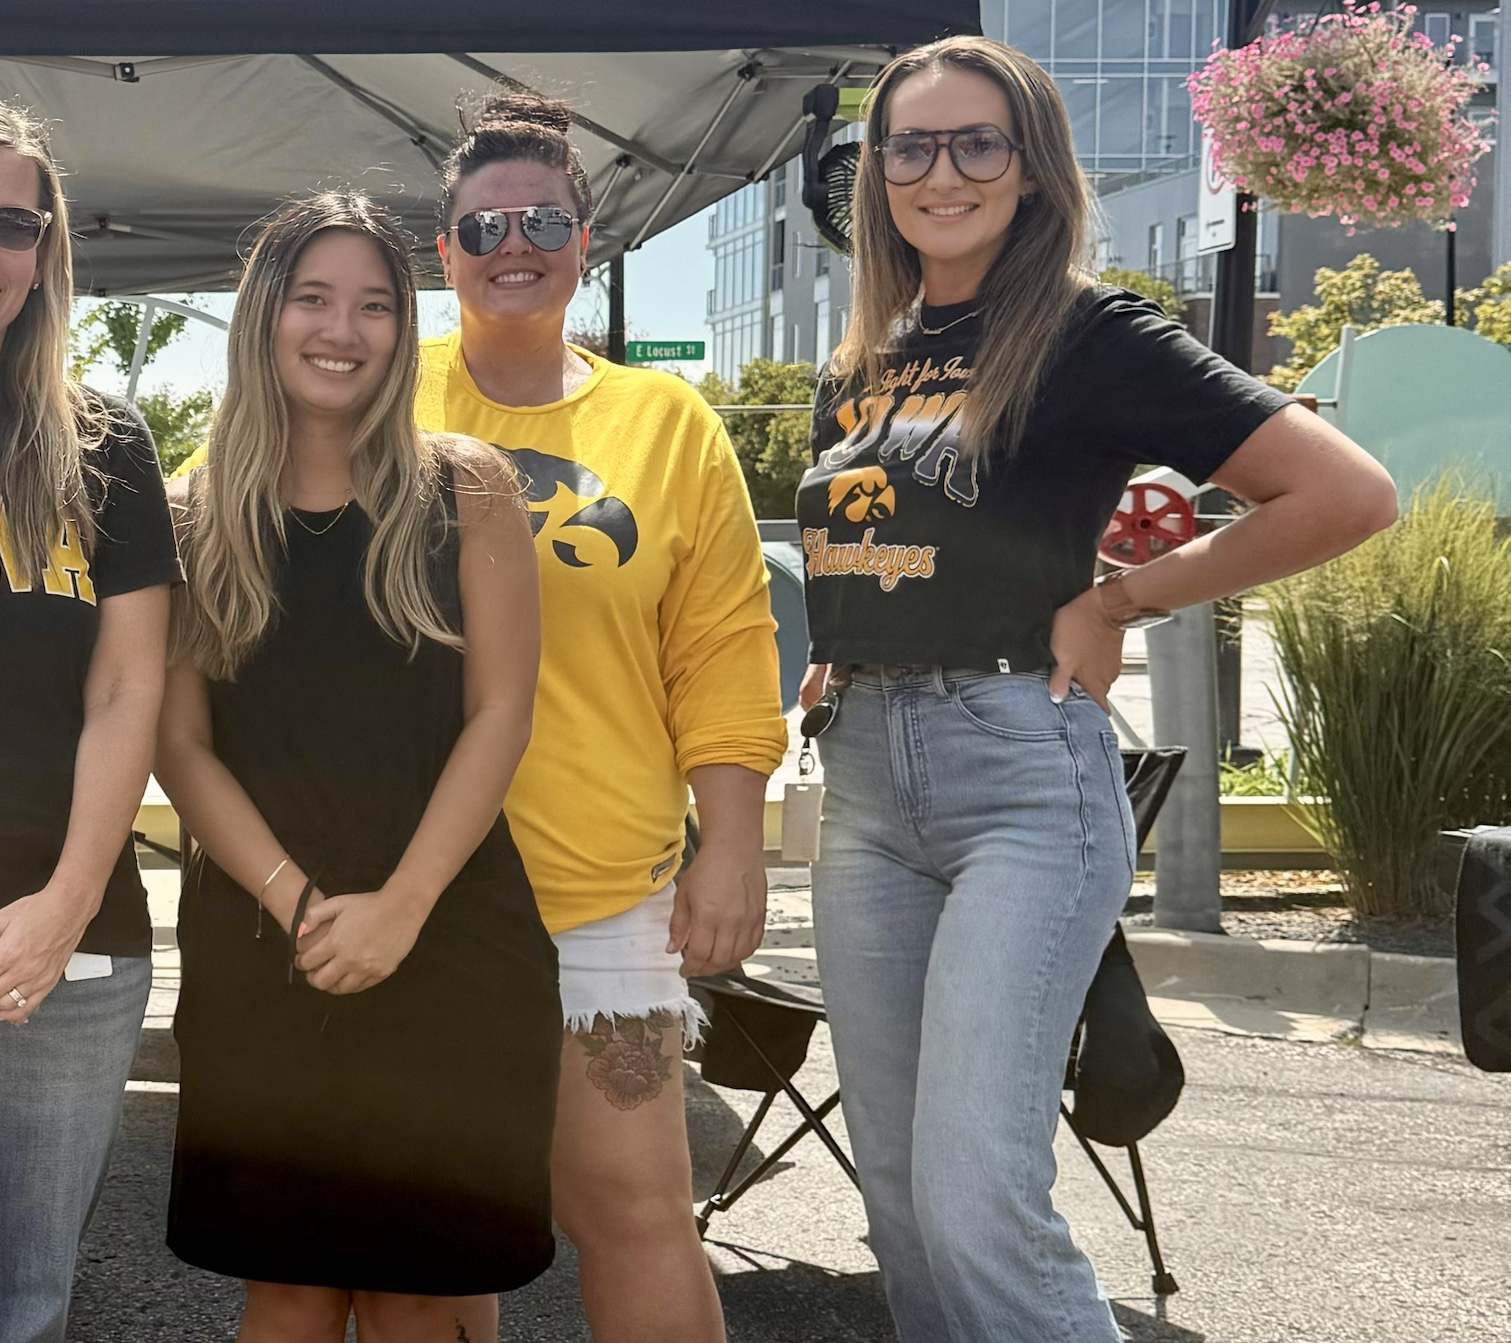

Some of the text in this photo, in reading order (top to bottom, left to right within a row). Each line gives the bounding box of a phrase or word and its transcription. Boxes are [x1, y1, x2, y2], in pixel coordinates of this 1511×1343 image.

[635, 343, 696, 358] E Locust St
[910, 357, 940, 393] for
[803, 527, 935, 592] Hawkeyes
